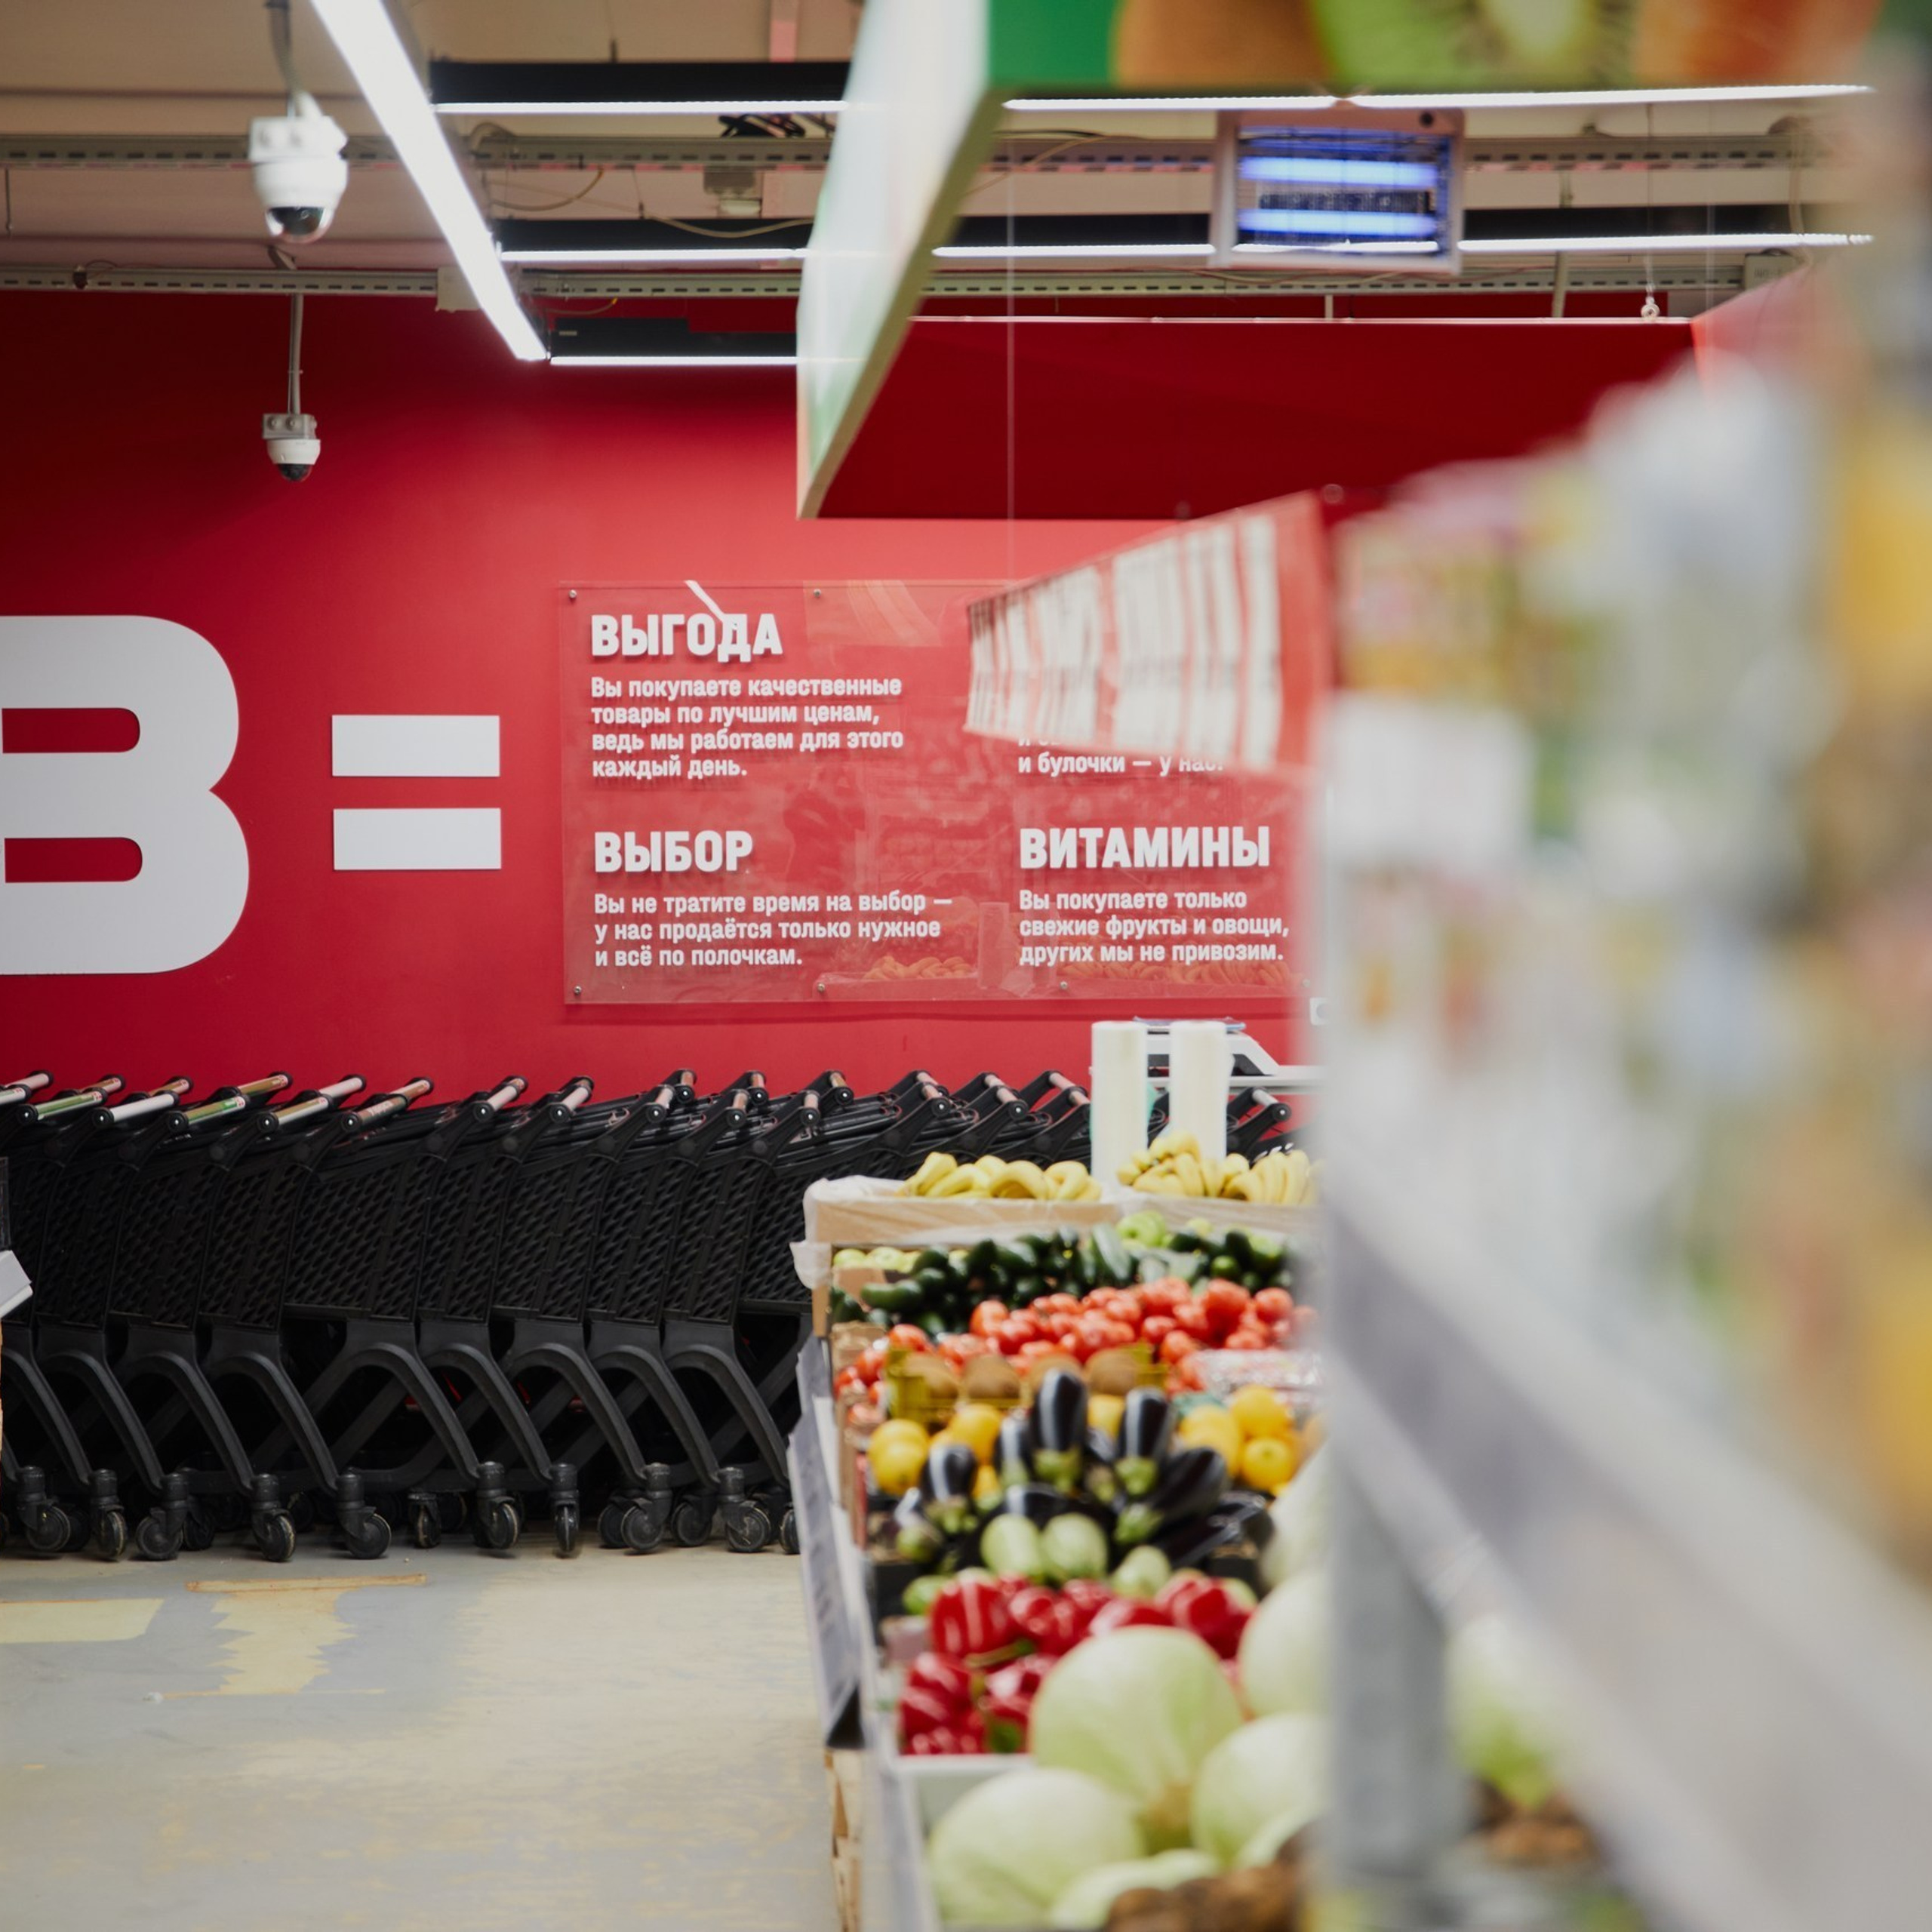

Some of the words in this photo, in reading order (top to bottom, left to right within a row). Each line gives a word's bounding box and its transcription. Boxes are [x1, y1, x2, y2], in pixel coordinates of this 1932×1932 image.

[591, 612, 783, 663] ВЫГОДА
[591, 677, 622, 697] Вы
[629, 679, 742, 701] покупаете
[748, 678, 903, 696] качественные
[591, 707, 671, 728] товары
[677, 707, 703, 723] по
[709, 706, 797, 727] лучшим
[804, 706, 880, 725] ценам,
[592, 734, 645, 754] ведь
[651, 734, 684, 750] мы
[691, 728, 794, 754] работаем
[800, 733, 841, 752] для
[847, 731, 904, 749] этого
[592, 755, 681, 780] каждый
[688, 760, 748, 780] день.
[1019, 756, 1032, 774] и
[1038, 752, 1125, 777] булочки
[1160, 755, 1172, 777] у
[594, 830, 753, 873] ВЫБОР
[1019, 826, 1270, 869] ВИТАМИНЫ
[594, 894, 625, 914] Вы
[632, 897, 657, 914] не
[663, 896, 746, 918] тратите
[752, 895, 820, 916] время
[826, 895, 853, 912] на
[859, 890, 927, 915] выбор
[1019, 890, 1050, 910] Вы
[1057, 892, 1168, 914] покупаете
[1174, 891, 1247, 909] только
[595, 924, 608, 944] у
[614, 923, 653, 940] нас
[659, 918, 772, 944] продаётся
[779, 921, 851, 939] только
[858, 920, 941, 943] нужное
[1020, 919, 1100, 937] свежие
[1106, 914, 1187, 940] фрукты
[1193, 918, 1206, 934] и
[1212, 918, 1290, 938] овощи,
[595, 950, 608, 967] и
[614, 946, 652, 967] всё
[659, 949, 685, 967] по
[691, 949, 803, 966] полочкам.
[1019, 946, 1094, 967] других
[1100, 946, 1134, 962] мы
[1140, 945, 1165, 961] не
[1172, 945, 1284, 966] привозим.
